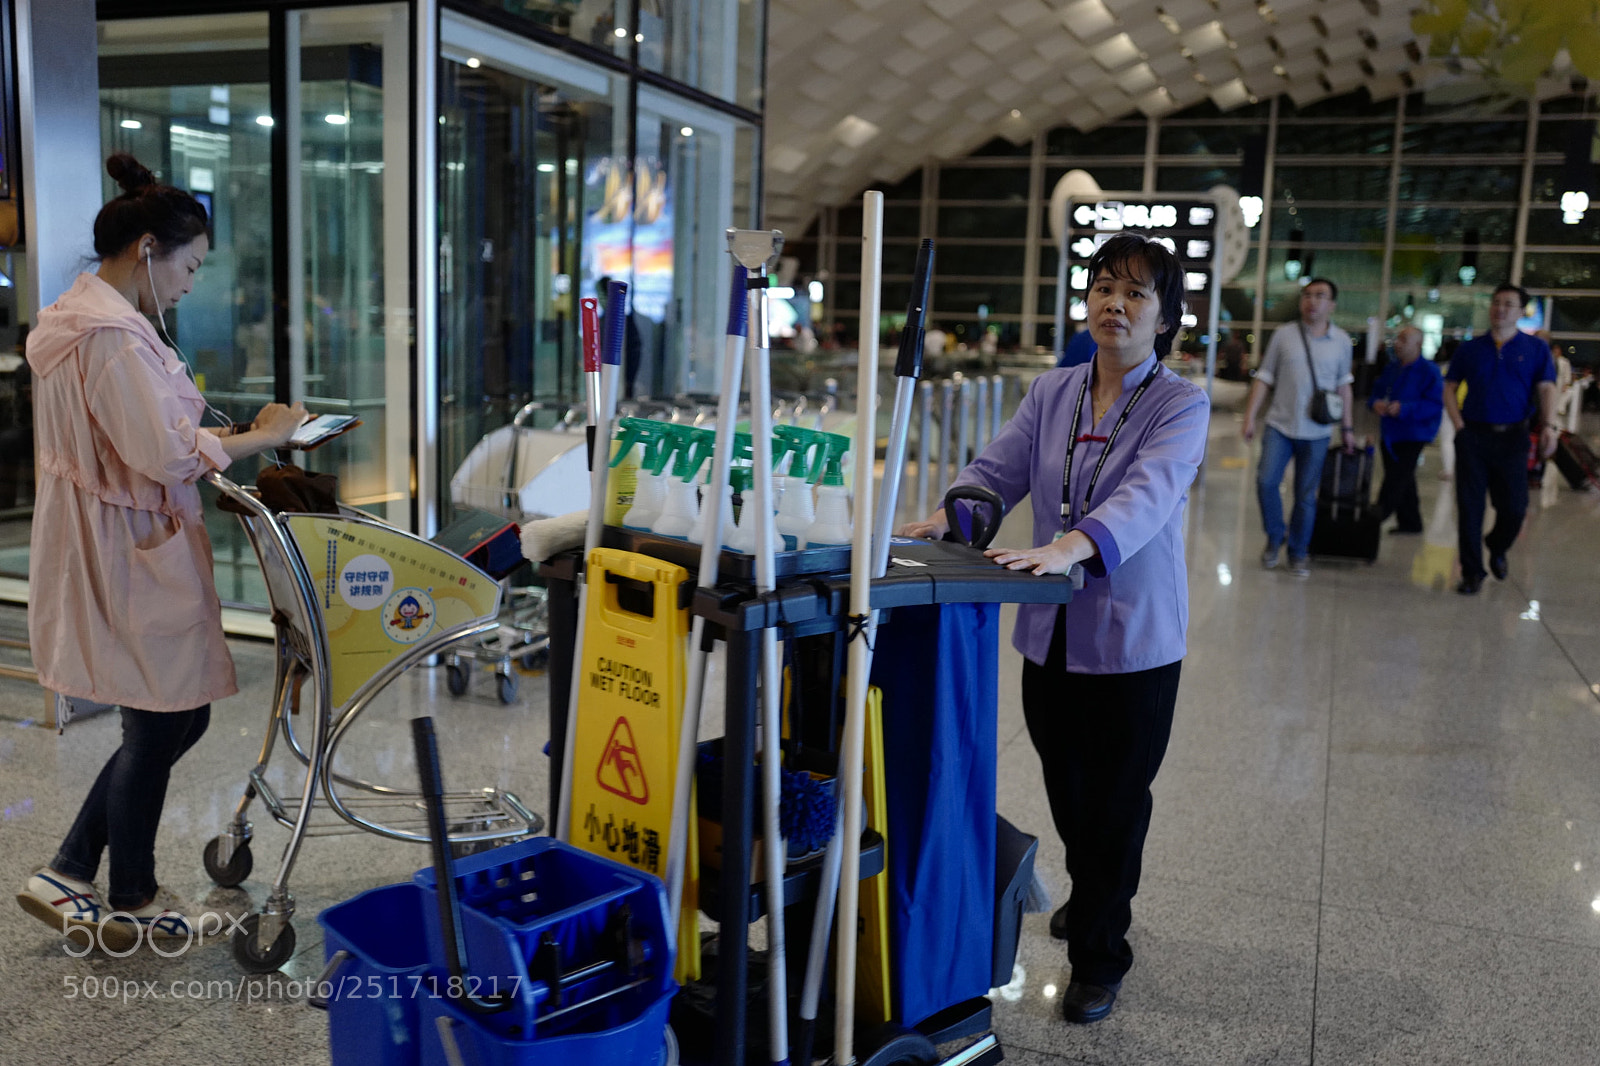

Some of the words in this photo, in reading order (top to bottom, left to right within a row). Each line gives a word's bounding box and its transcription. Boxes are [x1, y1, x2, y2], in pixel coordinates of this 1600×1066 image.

[590, 671, 614, 693] WET
[619, 680, 661, 709] FLOOR
[597, 656, 653, 688] CAUTION
[584, 803, 661, 873] 小心地滑
